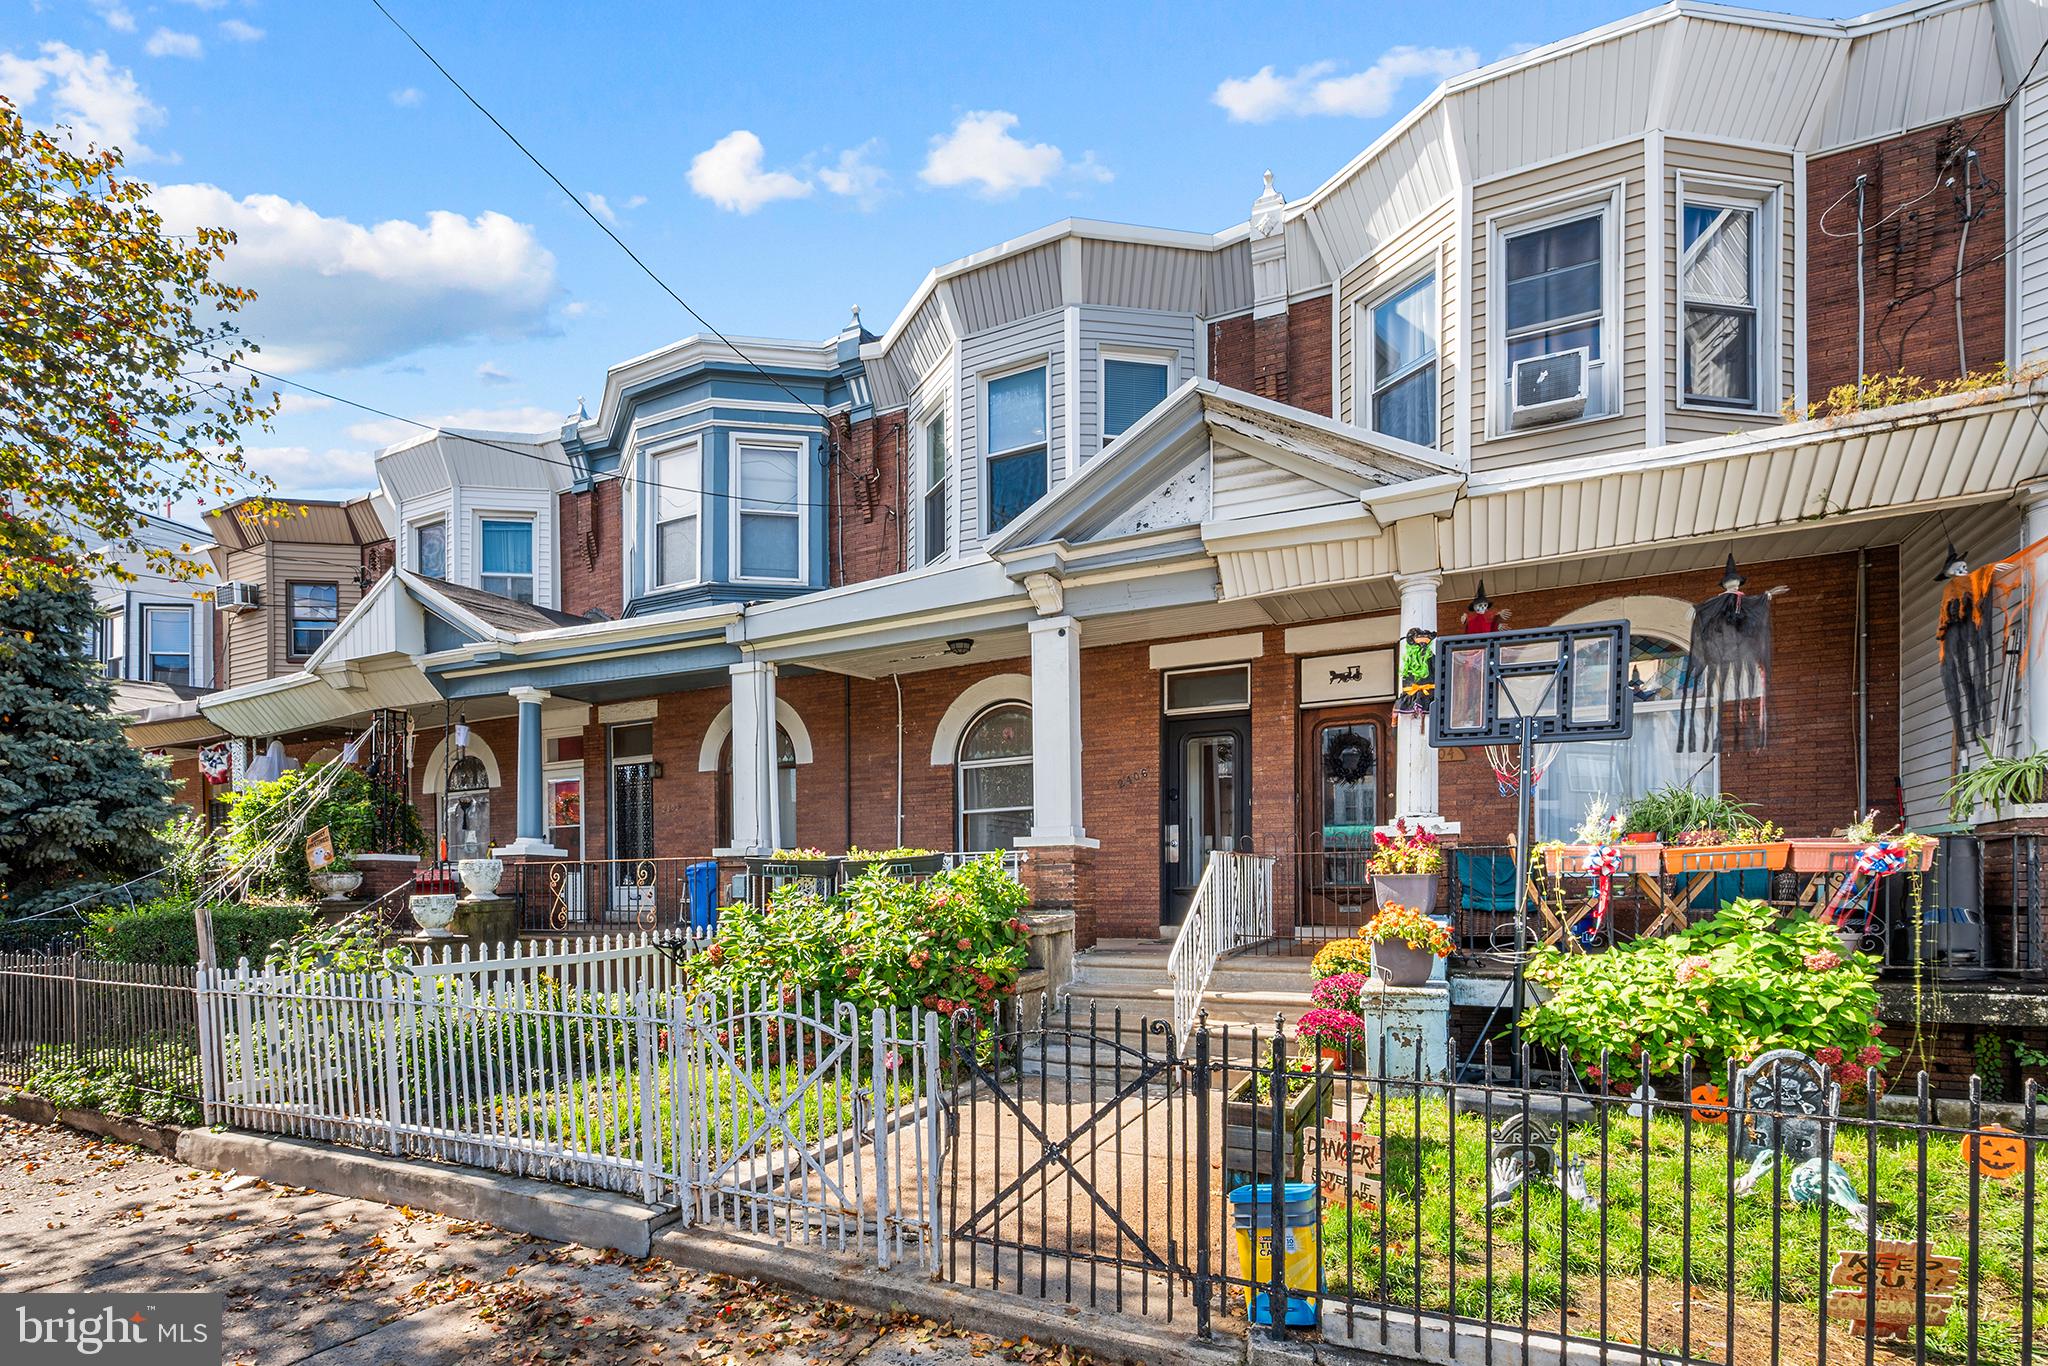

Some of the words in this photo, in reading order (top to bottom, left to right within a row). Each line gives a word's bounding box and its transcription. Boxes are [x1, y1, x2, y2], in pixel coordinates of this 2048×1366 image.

[1512, 1132, 1541, 1143] RP
[1360, 1182, 1371, 1192] IF
[1827, 1297, 1942, 1315] CONEMND
